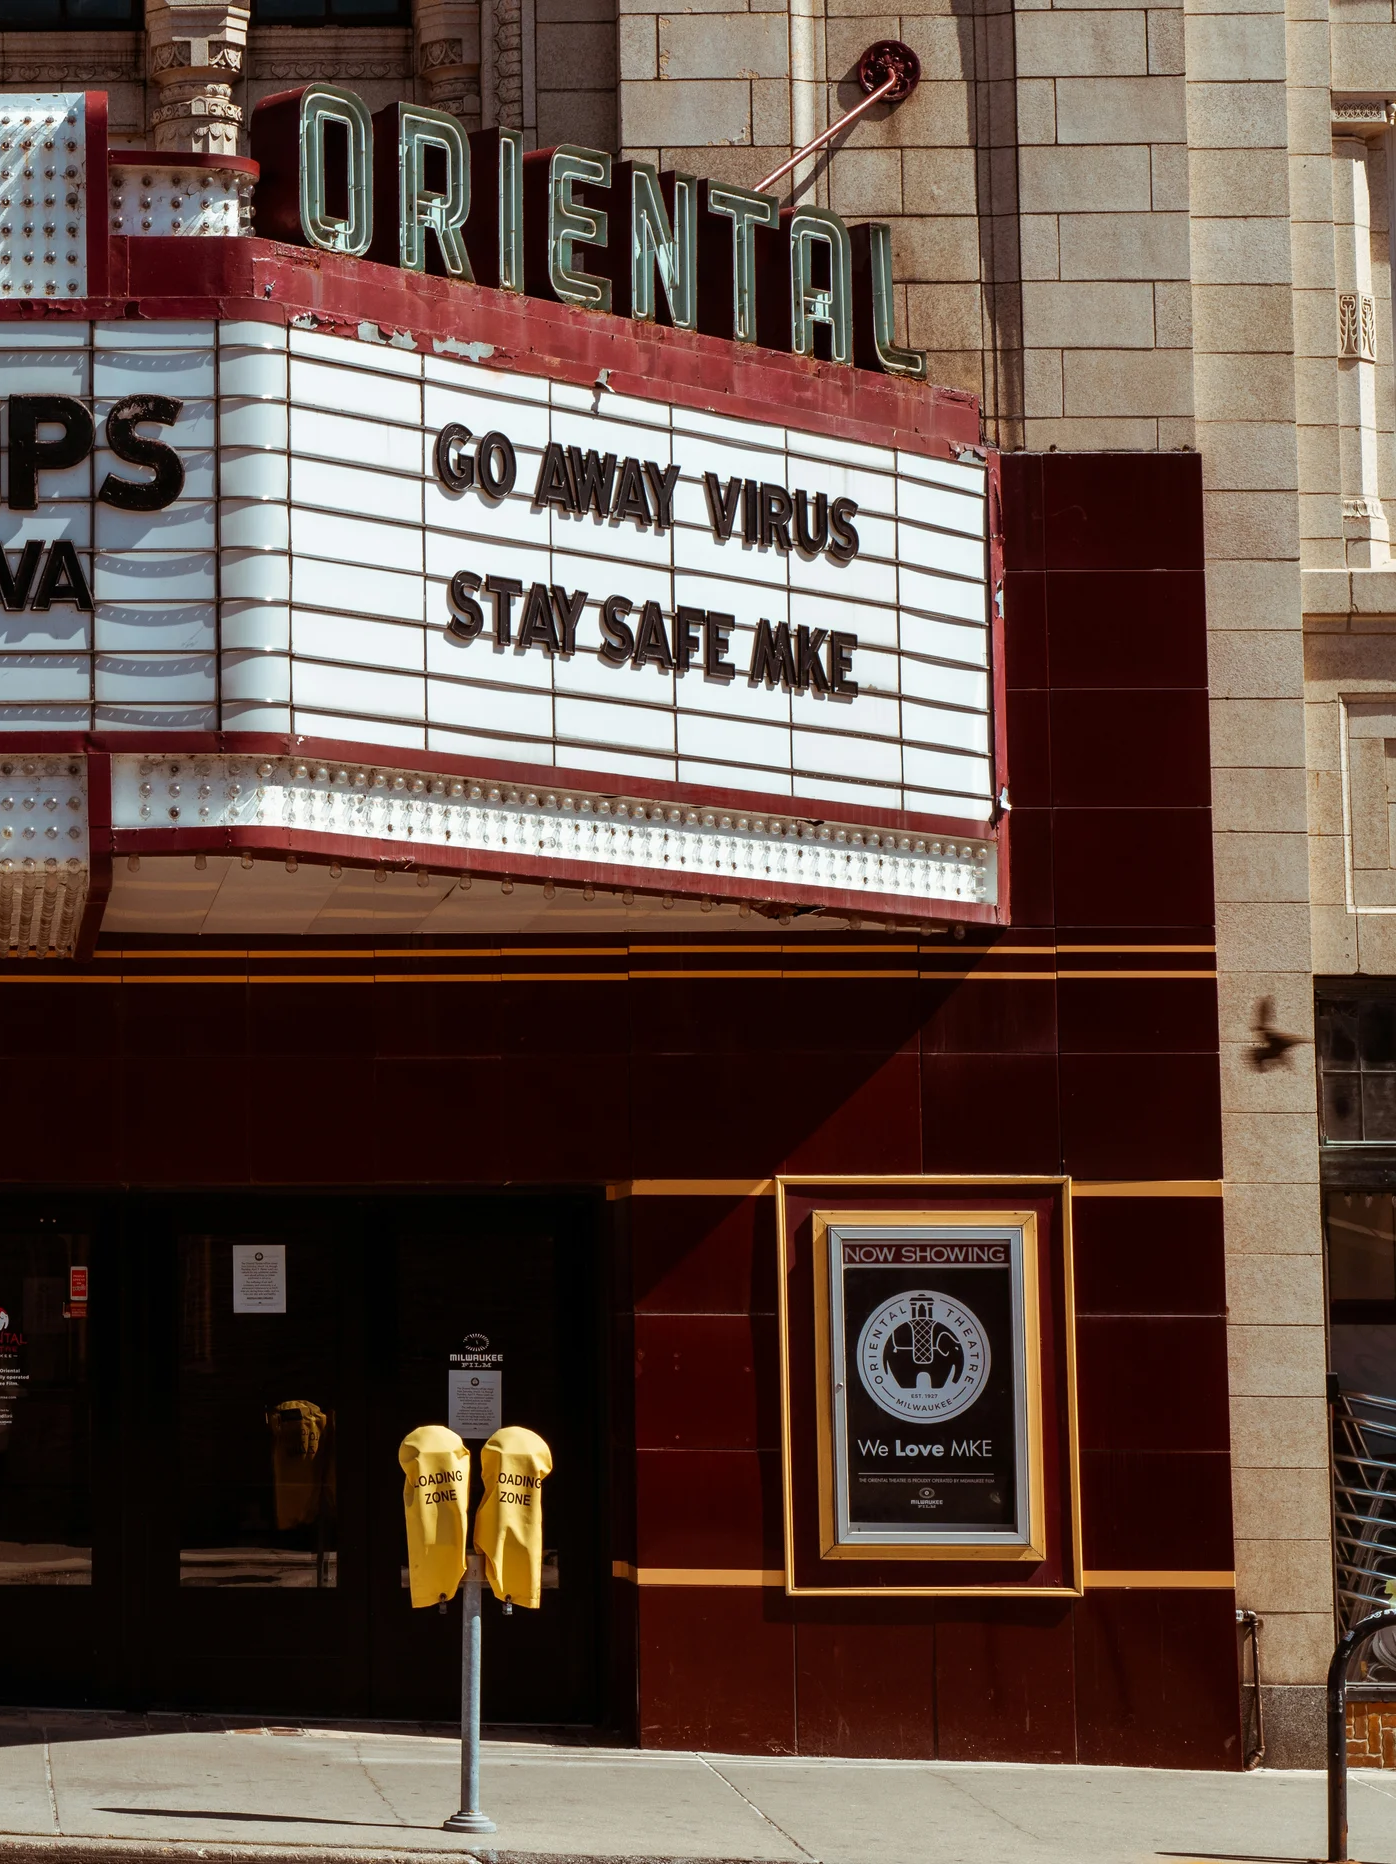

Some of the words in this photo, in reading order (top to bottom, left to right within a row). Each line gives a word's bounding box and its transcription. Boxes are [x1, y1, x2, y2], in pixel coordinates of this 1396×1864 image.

[298, 82, 928, 379] ORIENTAL
[435, 421, 518, 499] GO
[535, 441, 681, 530] AWAY
[703, 470, 860, 562] VIRUS
[447, 569, 589, 656] STAY
[598, 594, 737, 681] SAFE
[749, 617, 859, 698] MKE
[844, 1246, 896, 1262] NOW
[901, 1246, 1005, 1262] SHOWING
[868, 1306, 907, 1385] ORIENTAL
[945, 1308, 980, 1385] THEATRE
[449, 1353, 504, 1362] MILWAUKEE
[895, 1398, 953, 1412] MILWAUKEE
[857, 1439, 889, 1457] We
[895, 1439, 945, 1457] Love
[950, 1439, 993, 1457] MKE
[497, 1472, 542, 1489] OADING
[424, 1489, 457, 1505] ZONE
[499, 1491, 532, 1506] ZONE
